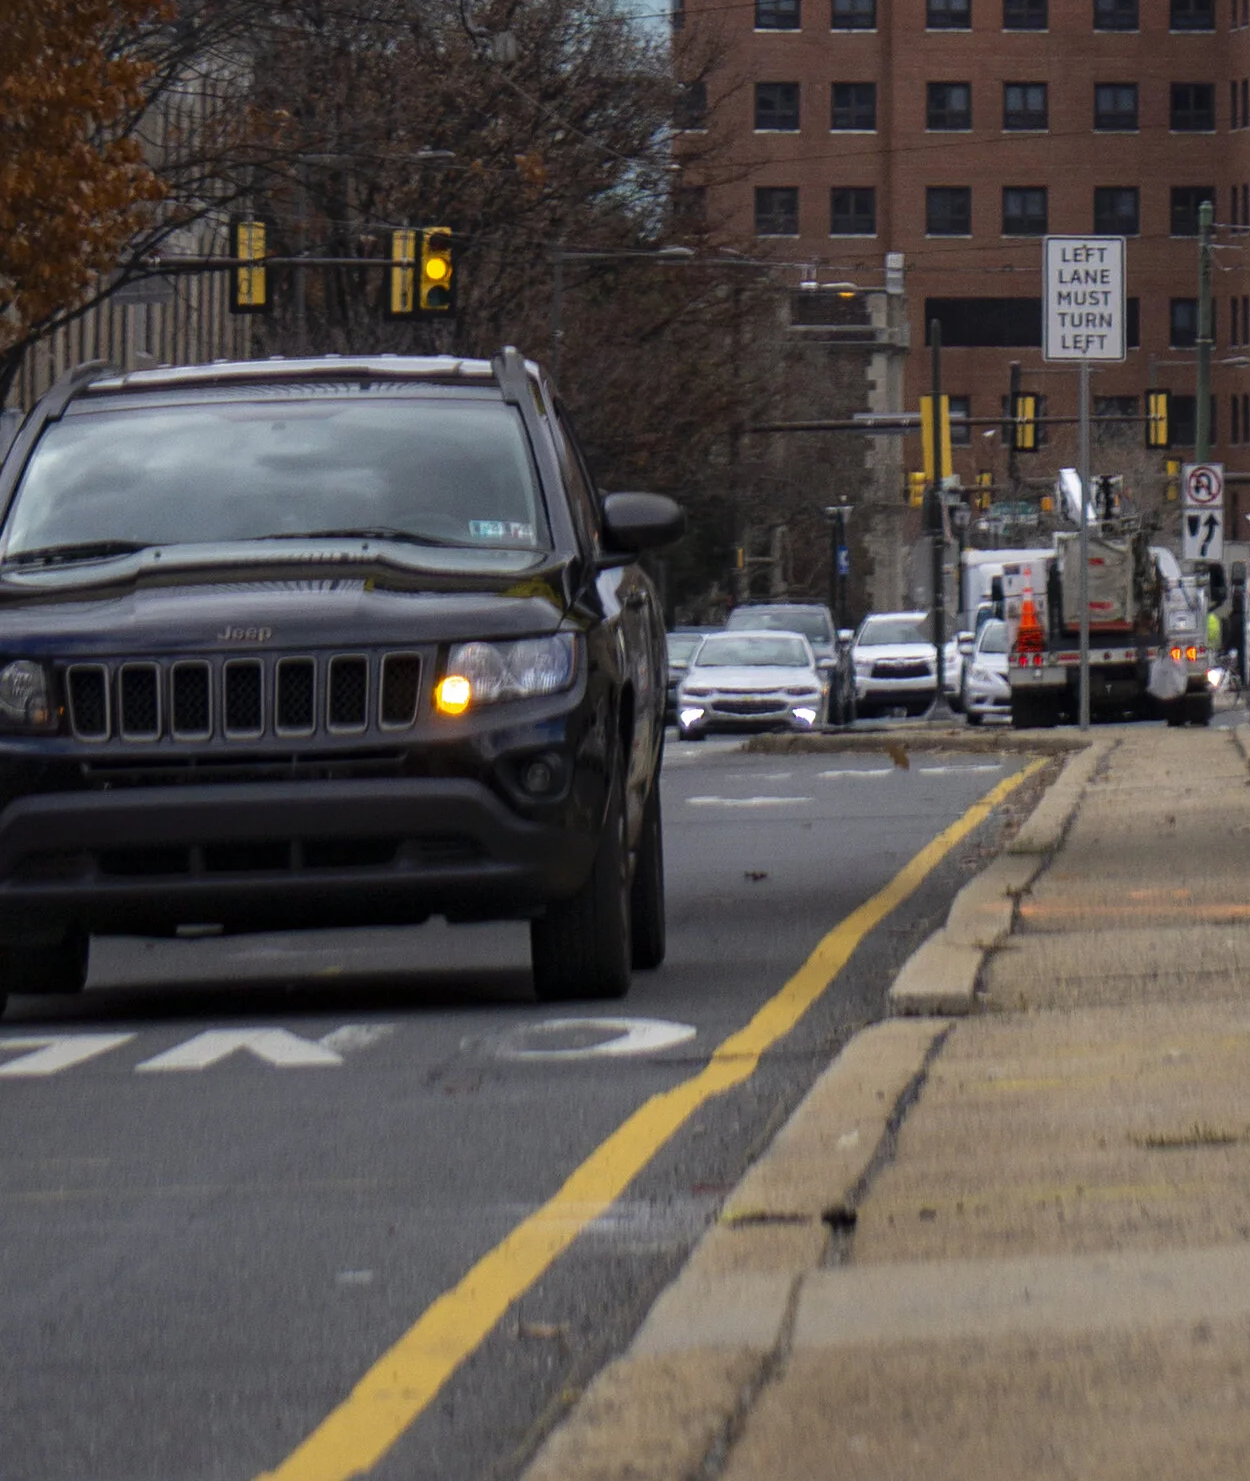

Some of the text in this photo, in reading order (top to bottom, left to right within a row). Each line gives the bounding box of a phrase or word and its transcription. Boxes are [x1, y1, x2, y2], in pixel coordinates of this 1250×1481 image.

[1061, 247, 1108, 263] LEFT
[1058, 268, 1111, 285] LANE
[1057, 290, 1112, 306] MUST
[1057, 312, 1113, 328] TURN
[1061, 334, 1108, 350] LEFT
[217, 625, 272, 642] Jeep
